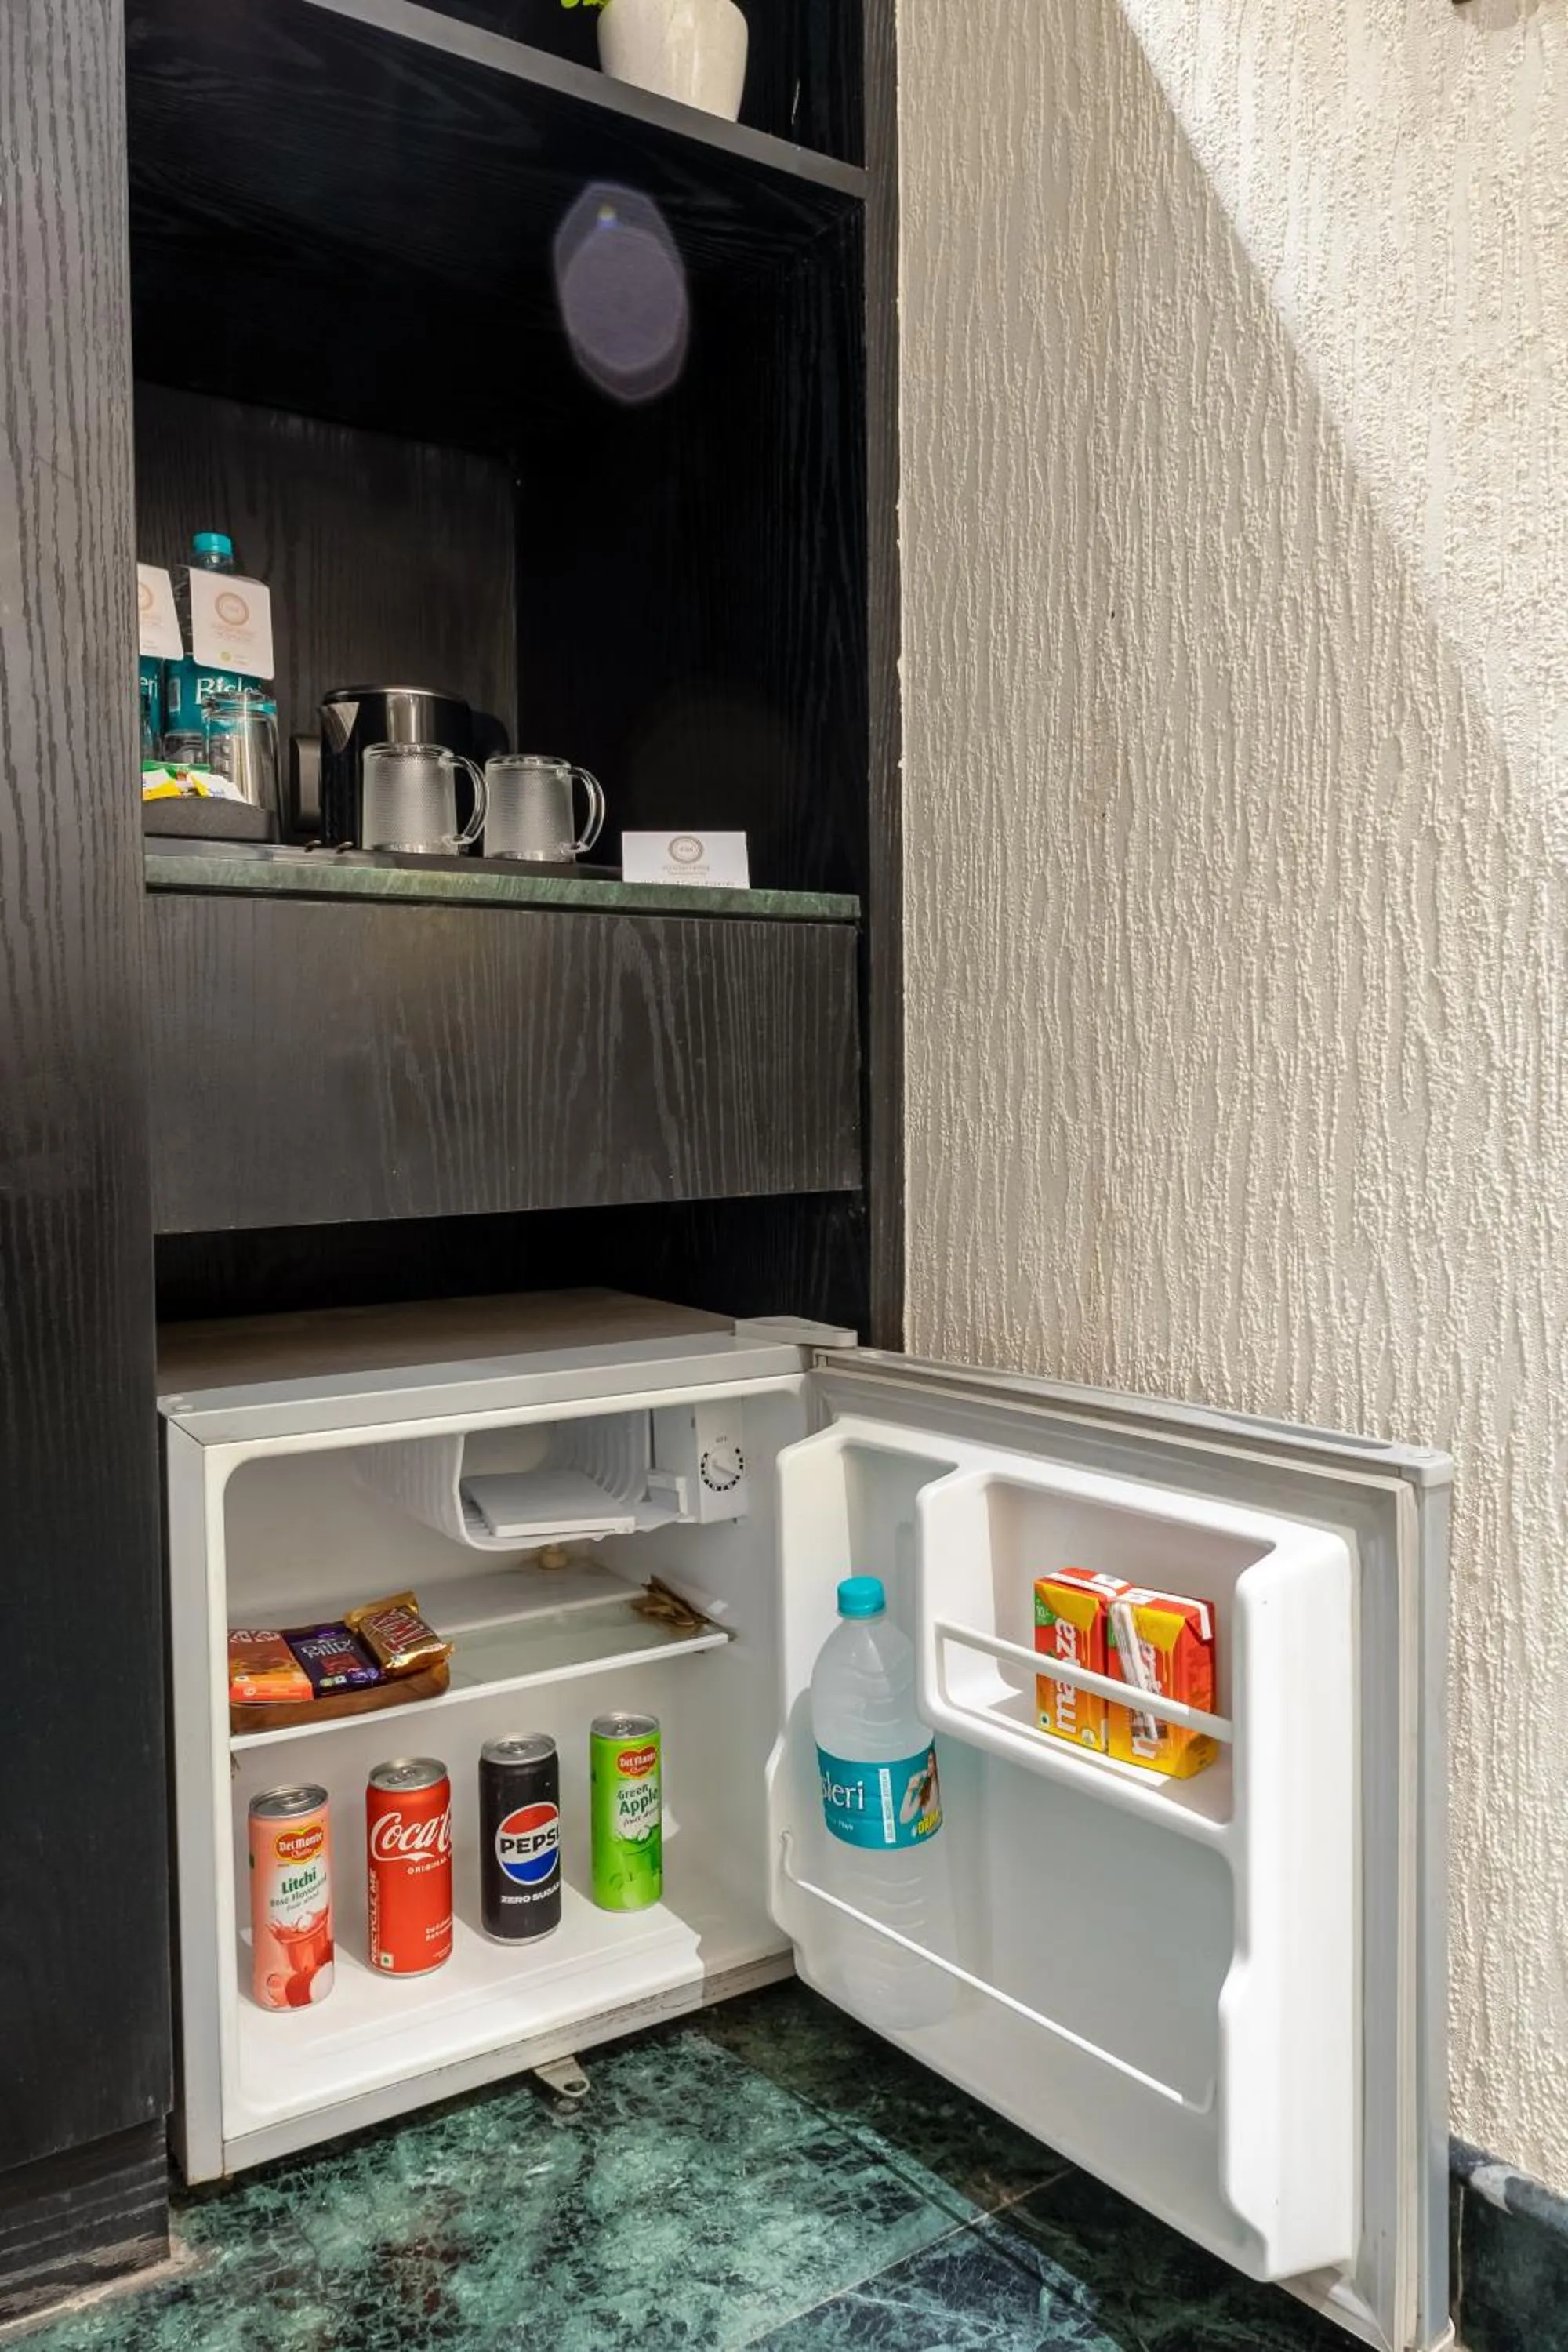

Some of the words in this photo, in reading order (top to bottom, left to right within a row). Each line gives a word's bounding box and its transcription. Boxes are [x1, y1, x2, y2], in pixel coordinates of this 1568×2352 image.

[617, 1784, 649, 1800] Green
[278, 1840, 296, 1852] Del
[500, 1824, 559, 1853] PEPSI
[282, 1867, 317, 1894] Litchi
[501, 1895, 531, 1905] ZERO
